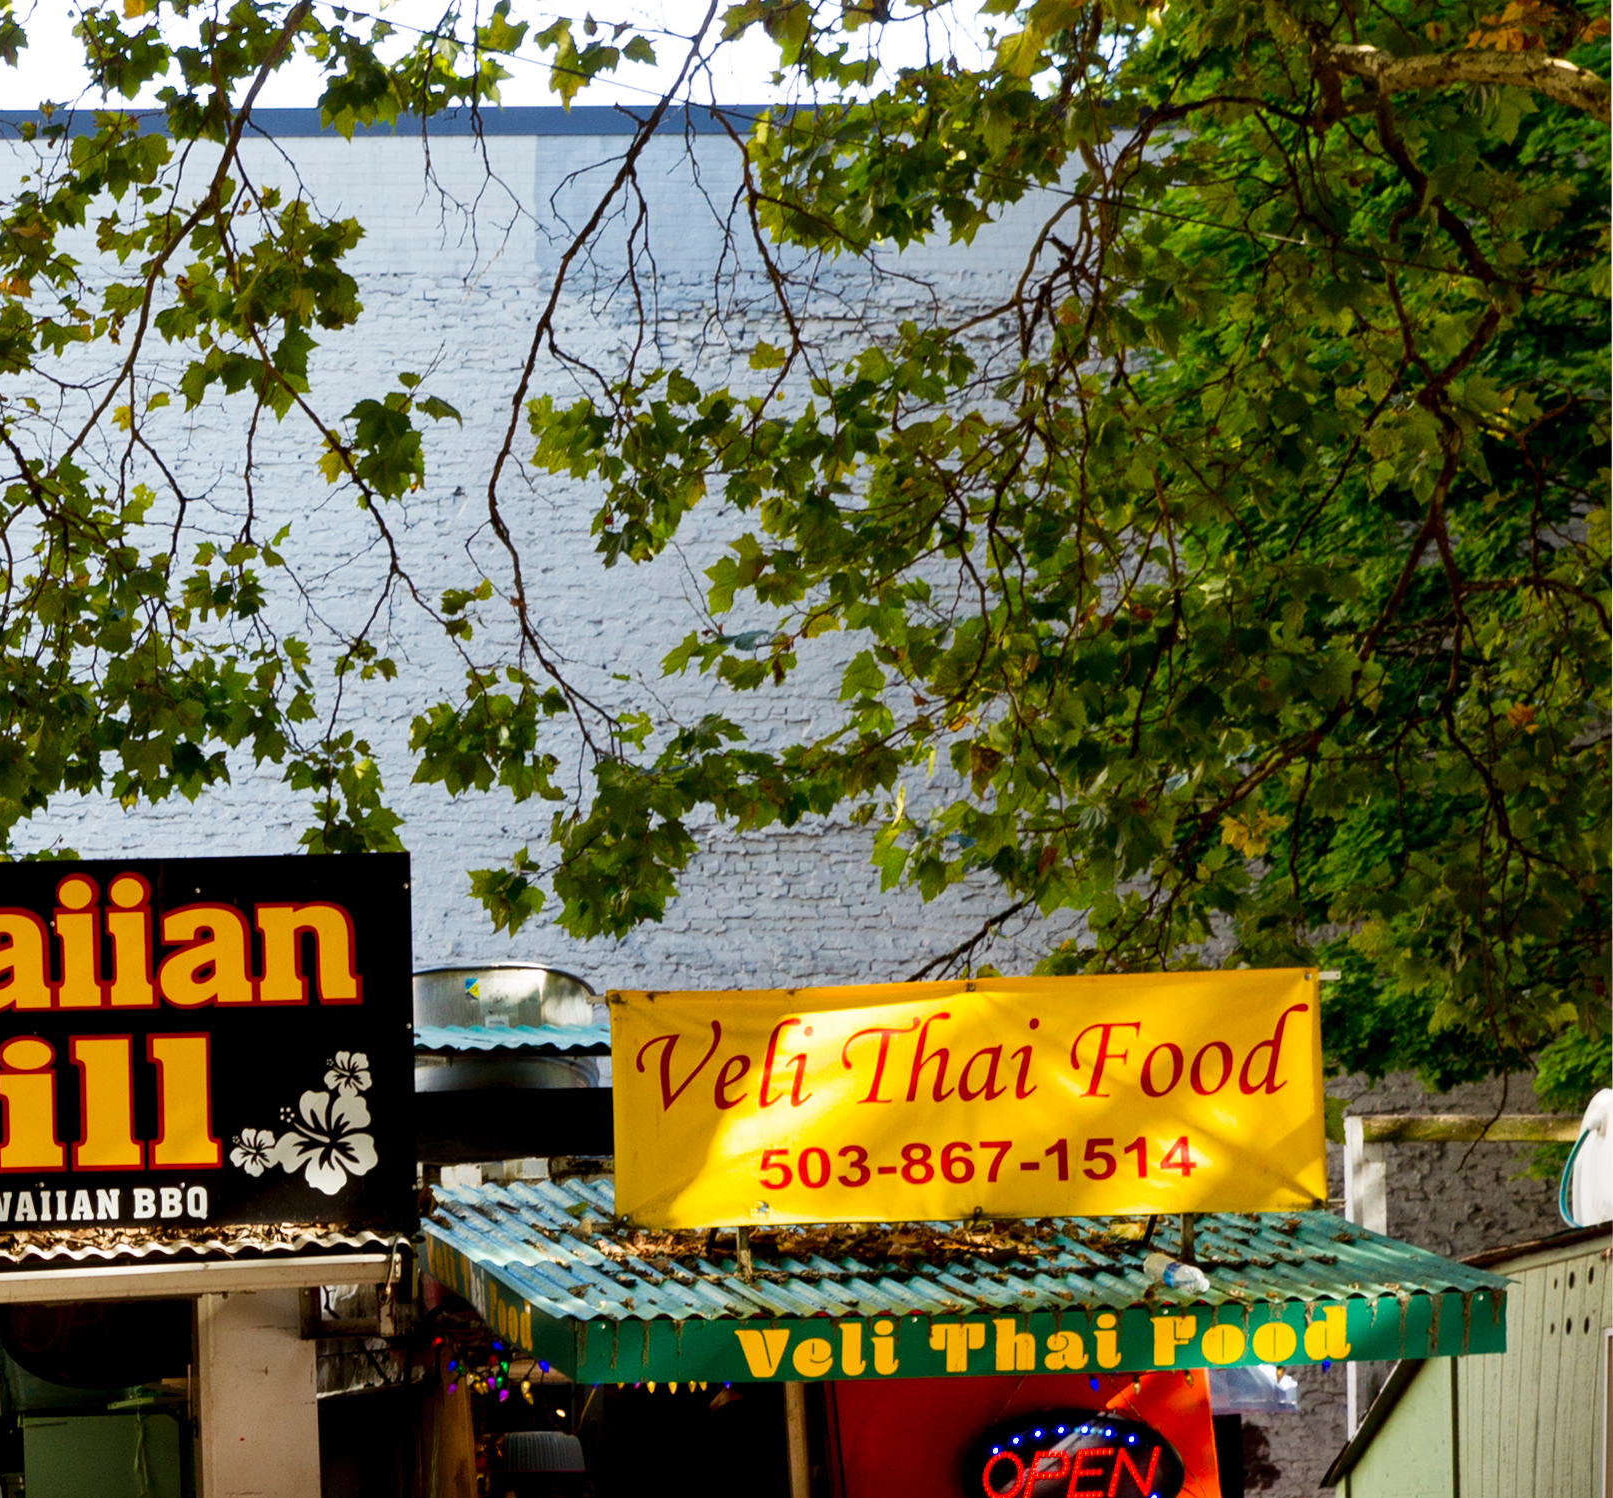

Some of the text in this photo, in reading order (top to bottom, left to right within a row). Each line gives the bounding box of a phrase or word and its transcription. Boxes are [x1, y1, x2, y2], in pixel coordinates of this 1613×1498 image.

[636, 1002, 1309, 1115] Veli Thai Food
[759, 1135, 1196, 1191] 503-867-1514
[133, 1186, 209, 1222] BBQ
[735, 1305, 1351, 1379] Veli Thai Food
